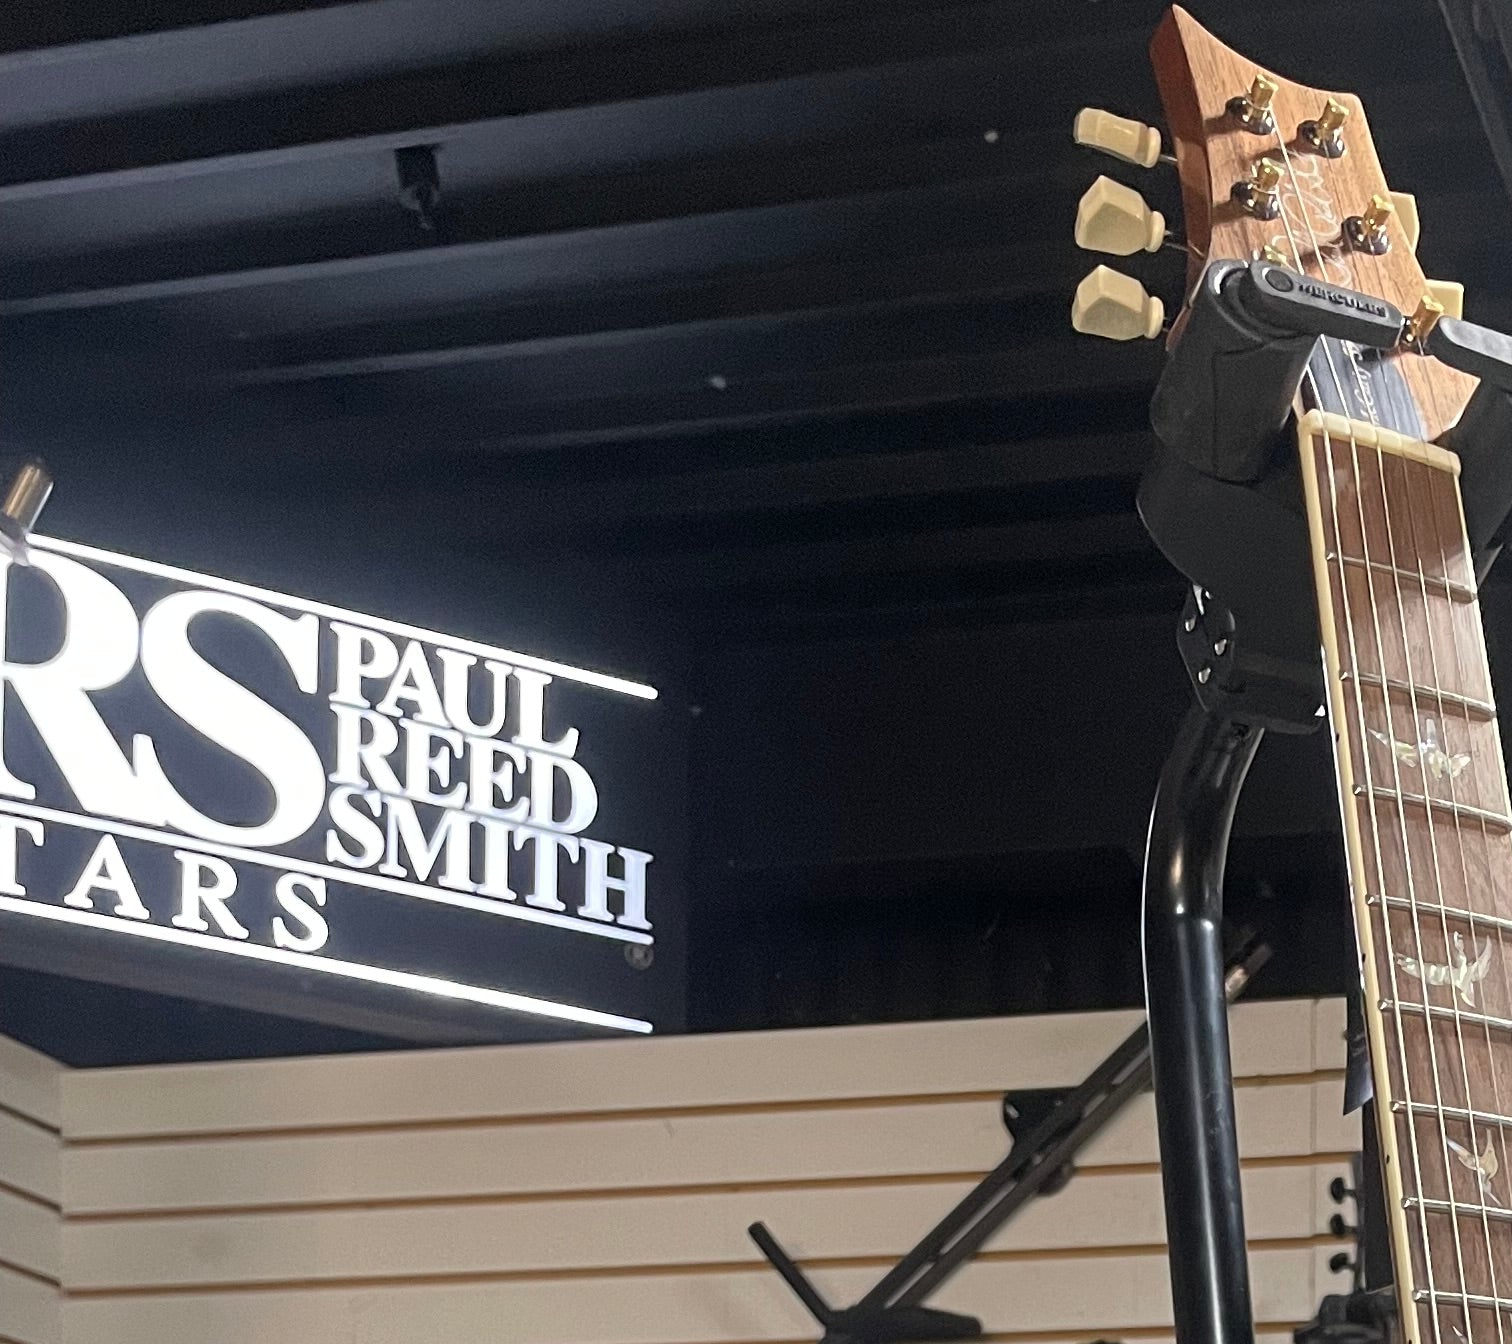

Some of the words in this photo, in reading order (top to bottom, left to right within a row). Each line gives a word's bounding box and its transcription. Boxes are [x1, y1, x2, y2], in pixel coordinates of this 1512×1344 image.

[329, 621, 579, 758] PAUL
[329, 702, 598, 835] REED
[326, 785, 654, 930] SMITH
